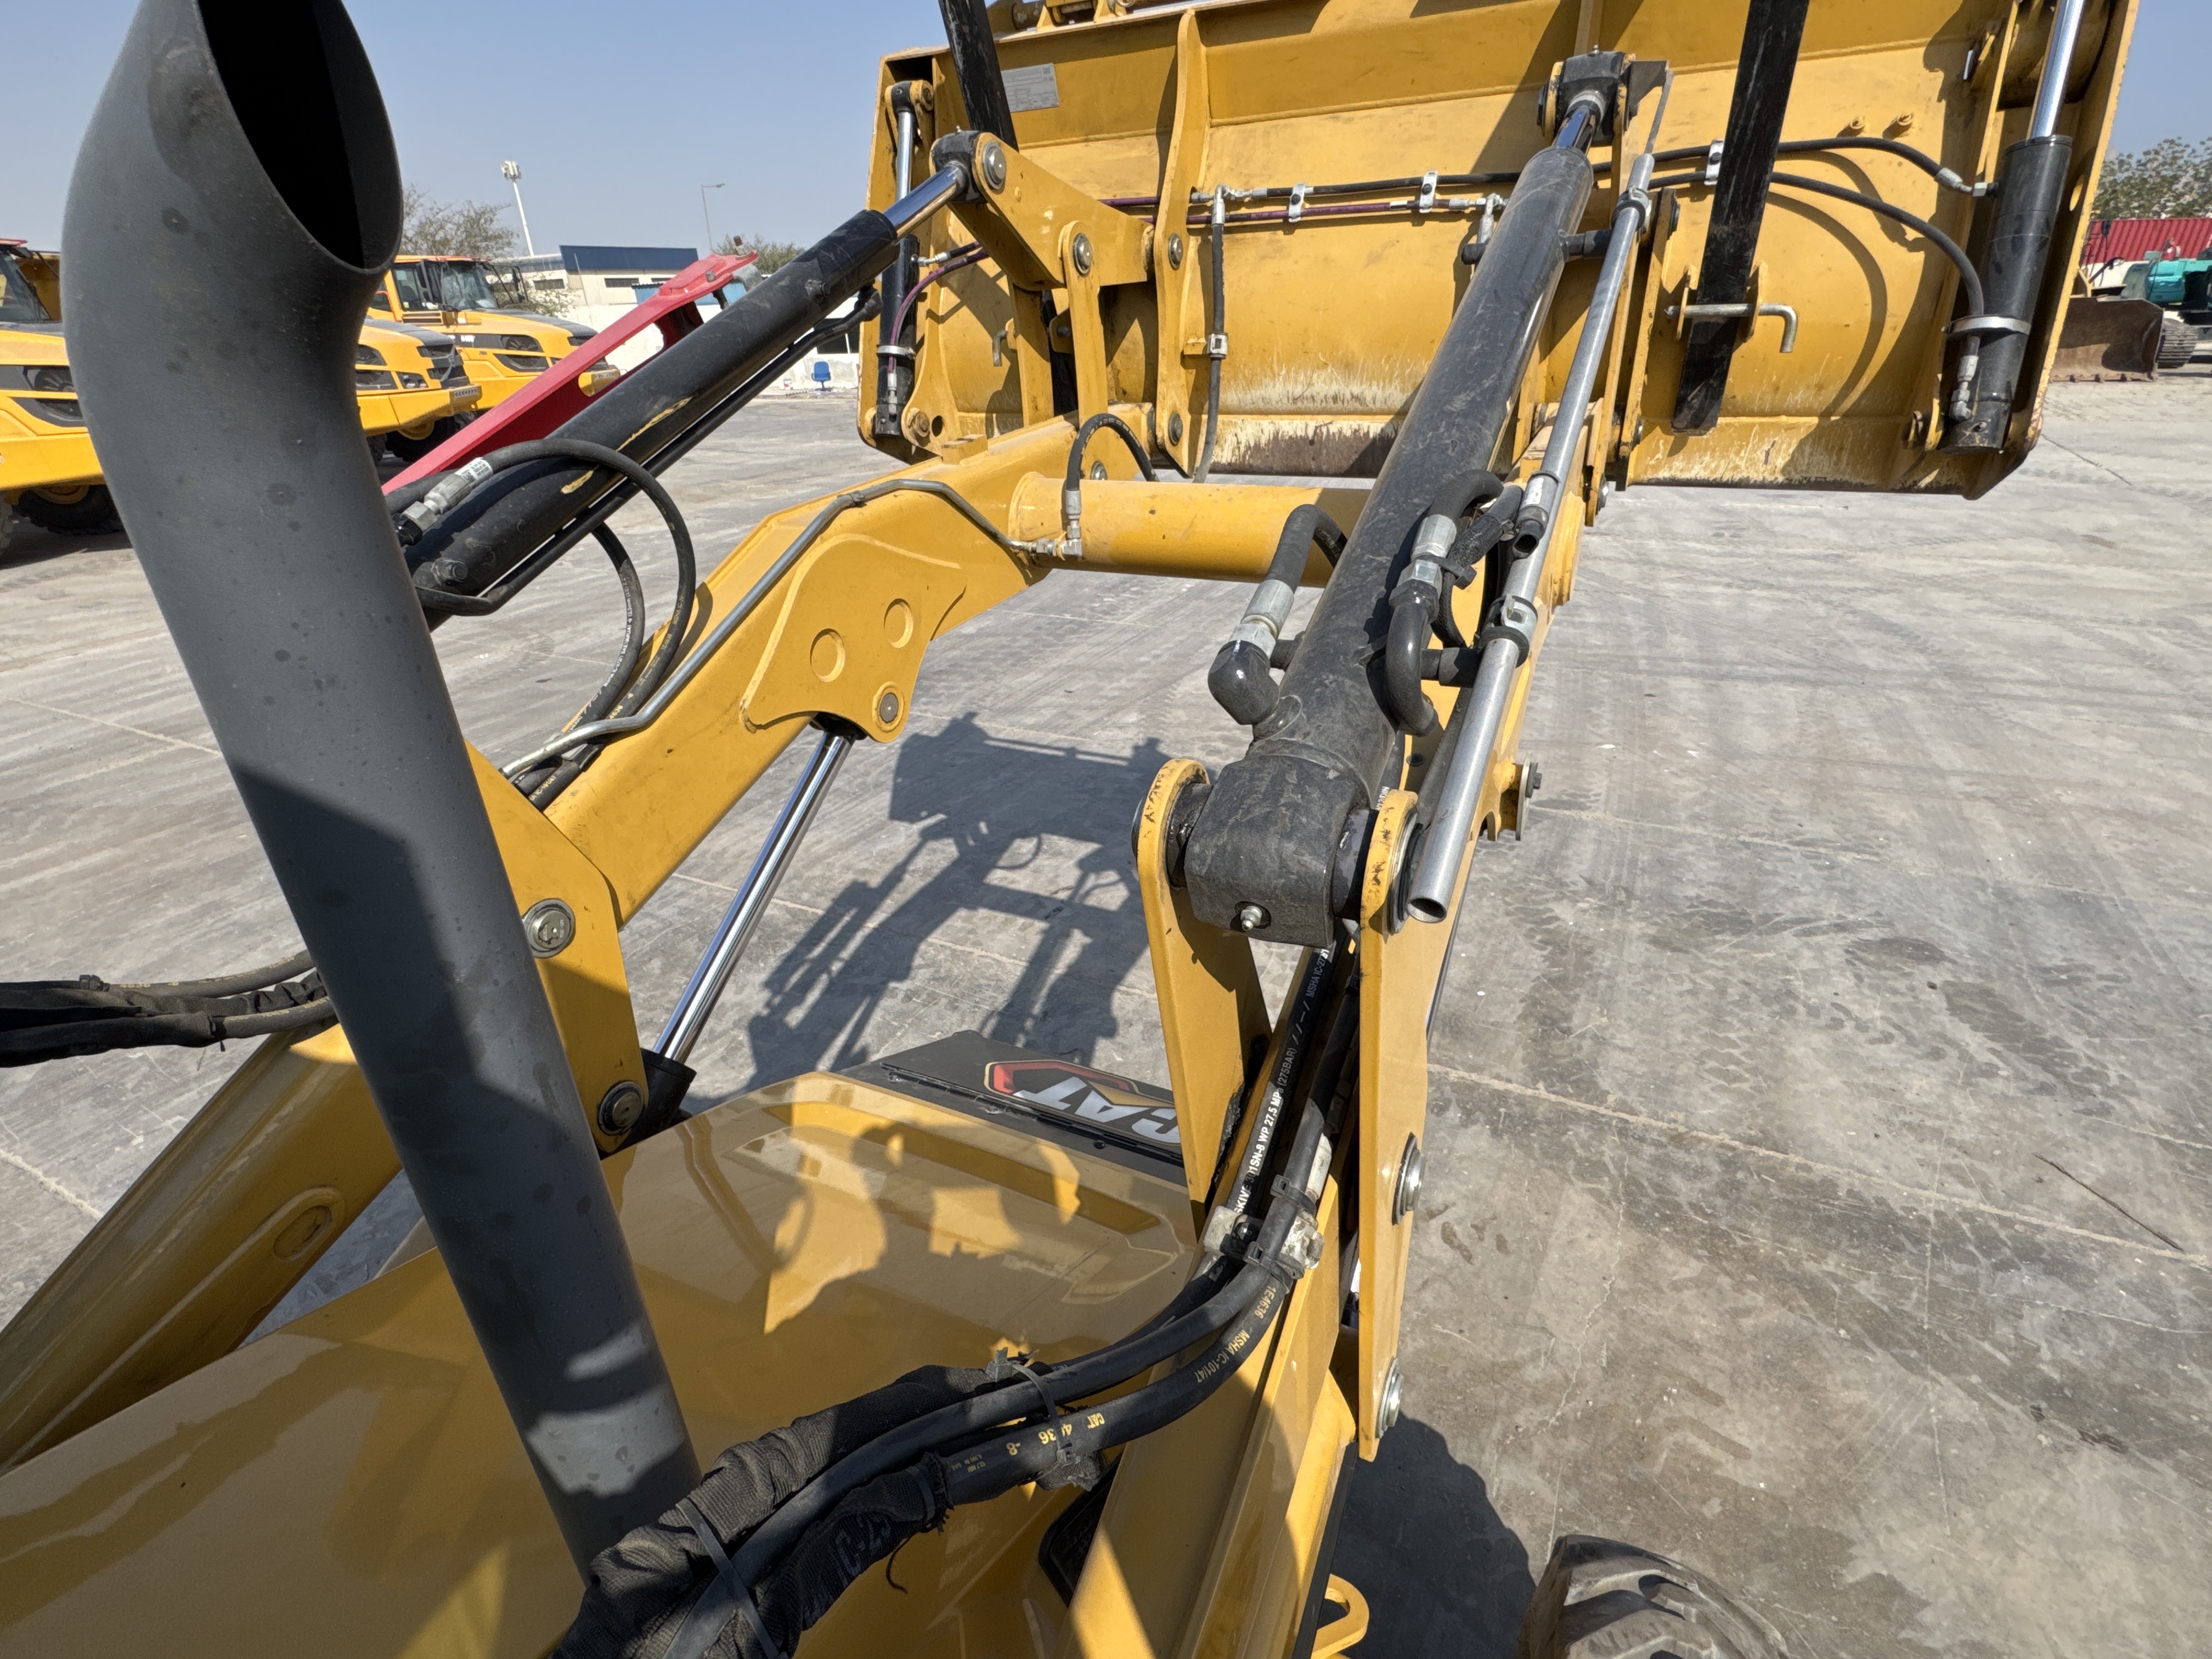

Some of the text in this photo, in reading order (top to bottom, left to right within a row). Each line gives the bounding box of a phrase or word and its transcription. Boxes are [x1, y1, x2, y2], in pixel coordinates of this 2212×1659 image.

[1306, 976, 1320, 998] MSHA
[1277, 1048, 1297, 1086] (275BAR)
[1270, 1087, 1284, 1107] MPa
[1264, 1106, 1278, 1127] 27,5
[1258, 1126, 1270, 1144] WP
[1194, 1286, 1277, 1383] 1E4636 MSHA IC-101/47
[1087, 1412, 1105, 1429] CAT
[1006, 1442, 1021, 1456] -8
